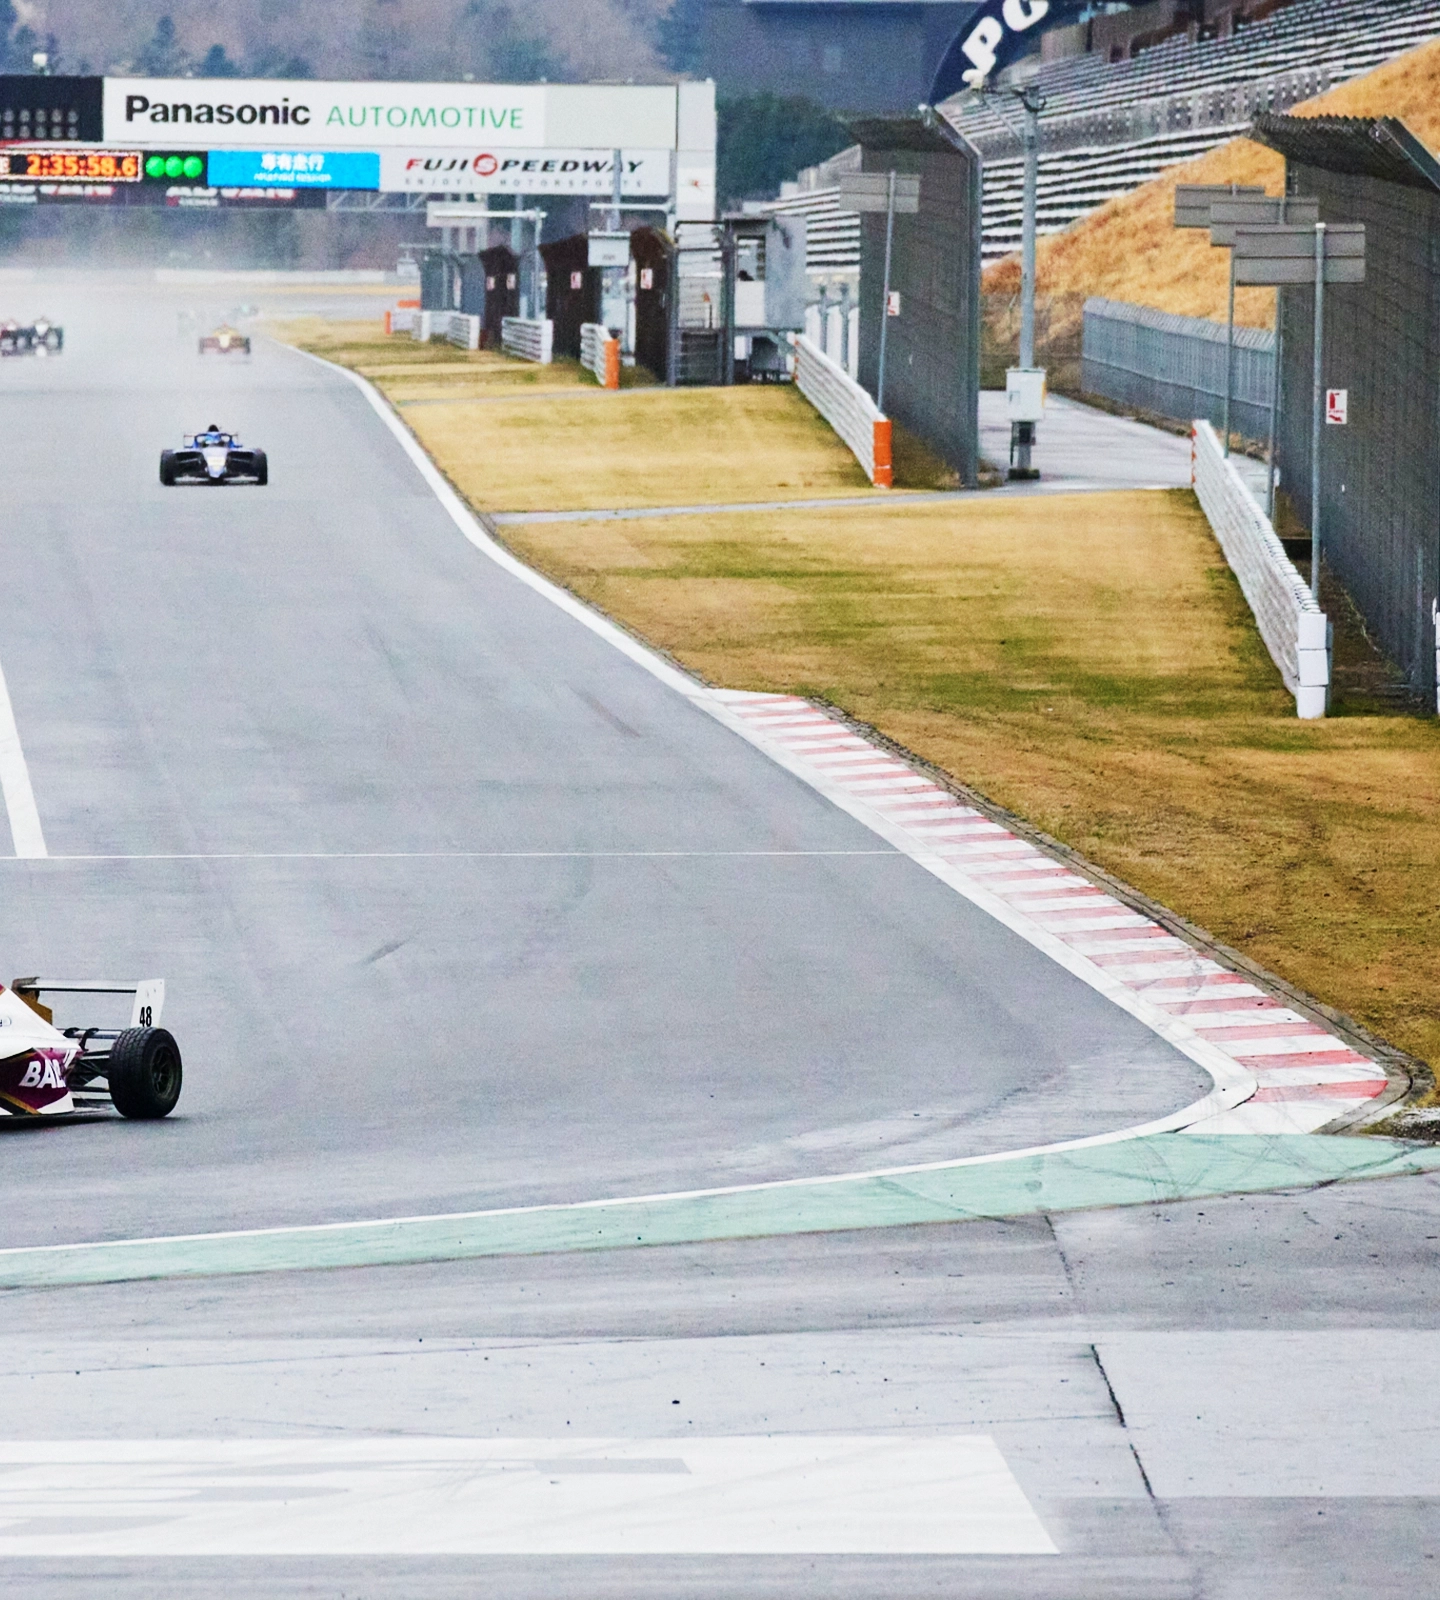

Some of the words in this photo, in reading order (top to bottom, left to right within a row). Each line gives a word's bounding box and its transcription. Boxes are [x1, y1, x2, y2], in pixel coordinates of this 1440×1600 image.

[125, 95, 311, 125] Panasonic
[326, 106, 524, 129] AUTOMOTIVE
[26, 154, 137, 178] 2:35:58.6
[406, 159, 468, 171] FUJI
[139, 1005, 153, 1028] 48
